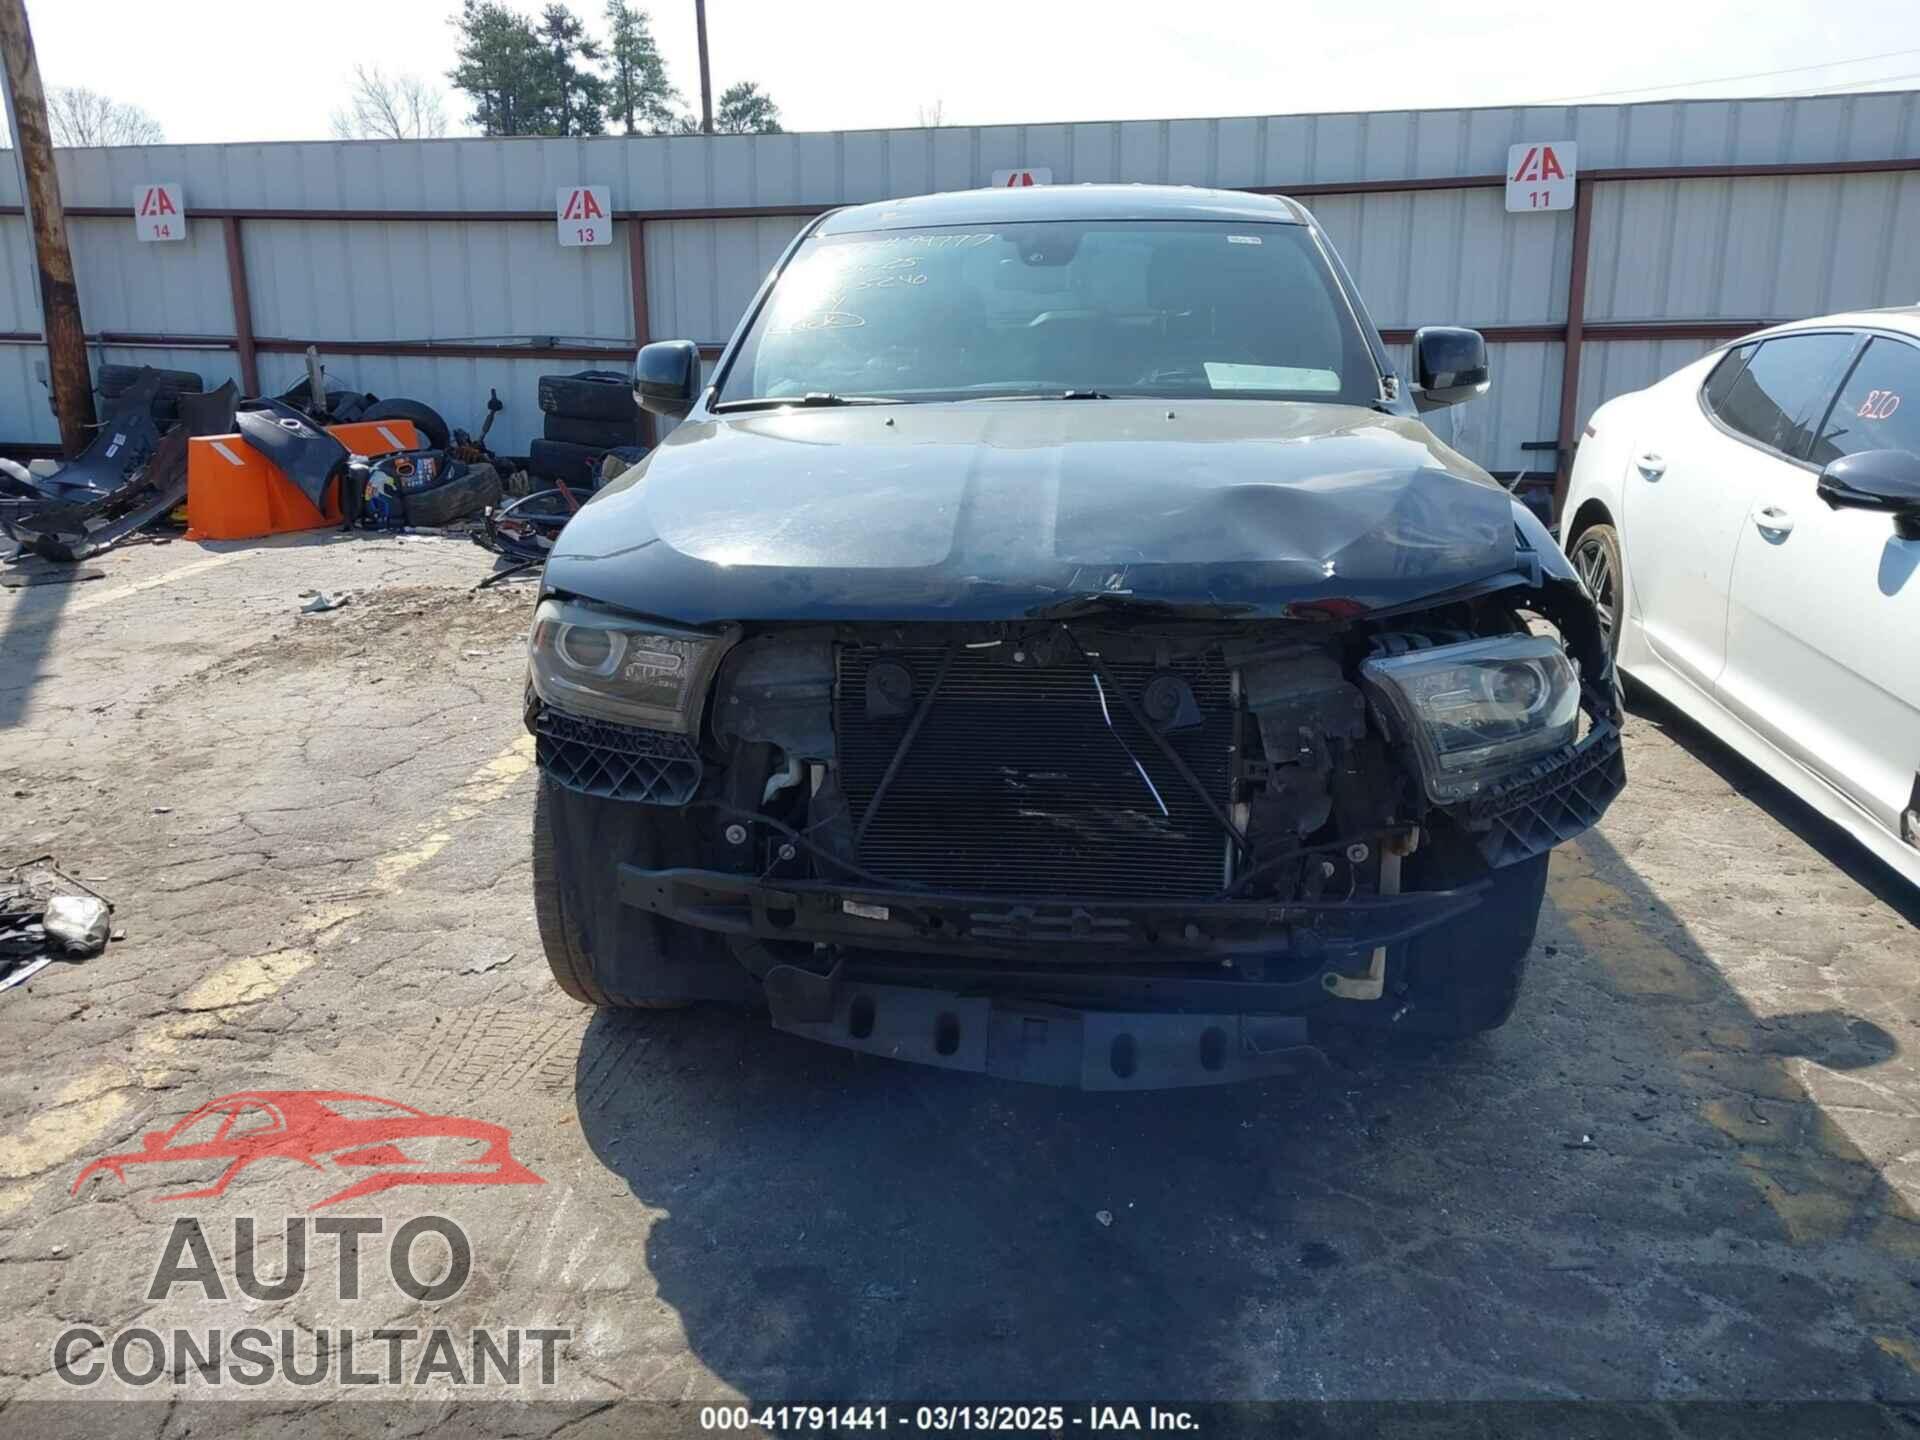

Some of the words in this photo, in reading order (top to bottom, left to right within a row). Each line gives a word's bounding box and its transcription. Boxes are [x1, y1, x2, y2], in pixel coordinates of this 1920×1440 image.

[1529, 191, 1550, 208] 11
[153, 224, 171, 238] 14
[577, 228, 594, 243] 13
